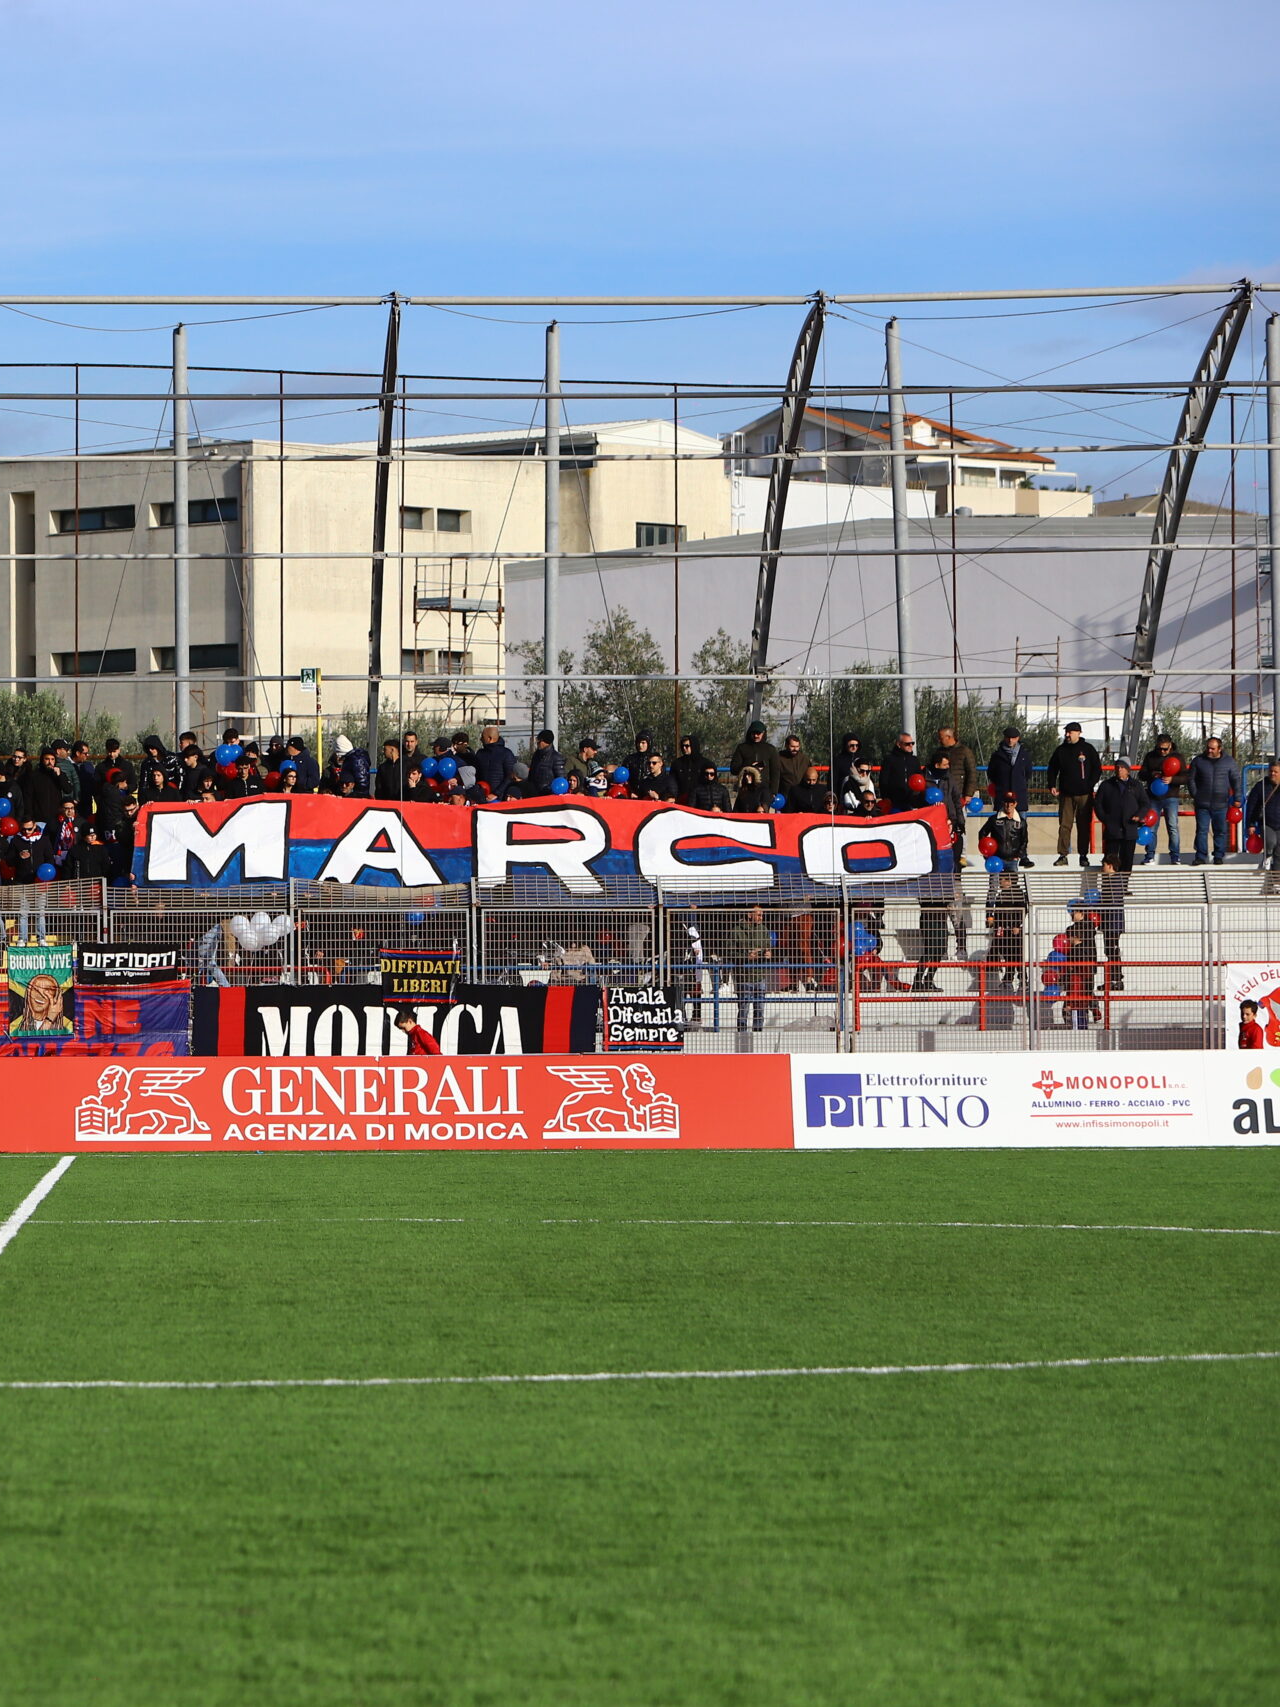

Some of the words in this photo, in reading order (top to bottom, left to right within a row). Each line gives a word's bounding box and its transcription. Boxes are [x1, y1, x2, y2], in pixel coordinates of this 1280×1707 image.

[145, 800, 938, 894] MARCO
[9, 953, 46, 970] BIONDO
[48, 952, 71, 969] VIVE
[82, 950, 177, 968] DIFFIDATI
[380, 959, 461, 975] DIFFIDATI
[392, 978, 448, 994] LIBERI
[1233, 976, 1260, 1003] FIGLI
[609, 987, 667, 1005] Amala
[609, 1024, 679, 1042] Sempre
[865, 1073, 988, 1086] Elettroforniture
[1066, 1075, 1167, 1090] MONOPOLI
[222, 1065, 524, 1116] GENERALI
[819, 1095, 989, 1128] PITINO
[1031, 1100, 1082, 1108] ALLUMINIO
[1172, 1099, 1191, 1107] PVC
[223, 1123, 357, 1141] AGENZIA
[366, 1123, 394, 1141] DI
[405, 1122, 528, 1140] MODICA
[1055, 1119, 1169, 1129] www.infissimonopoli.it
